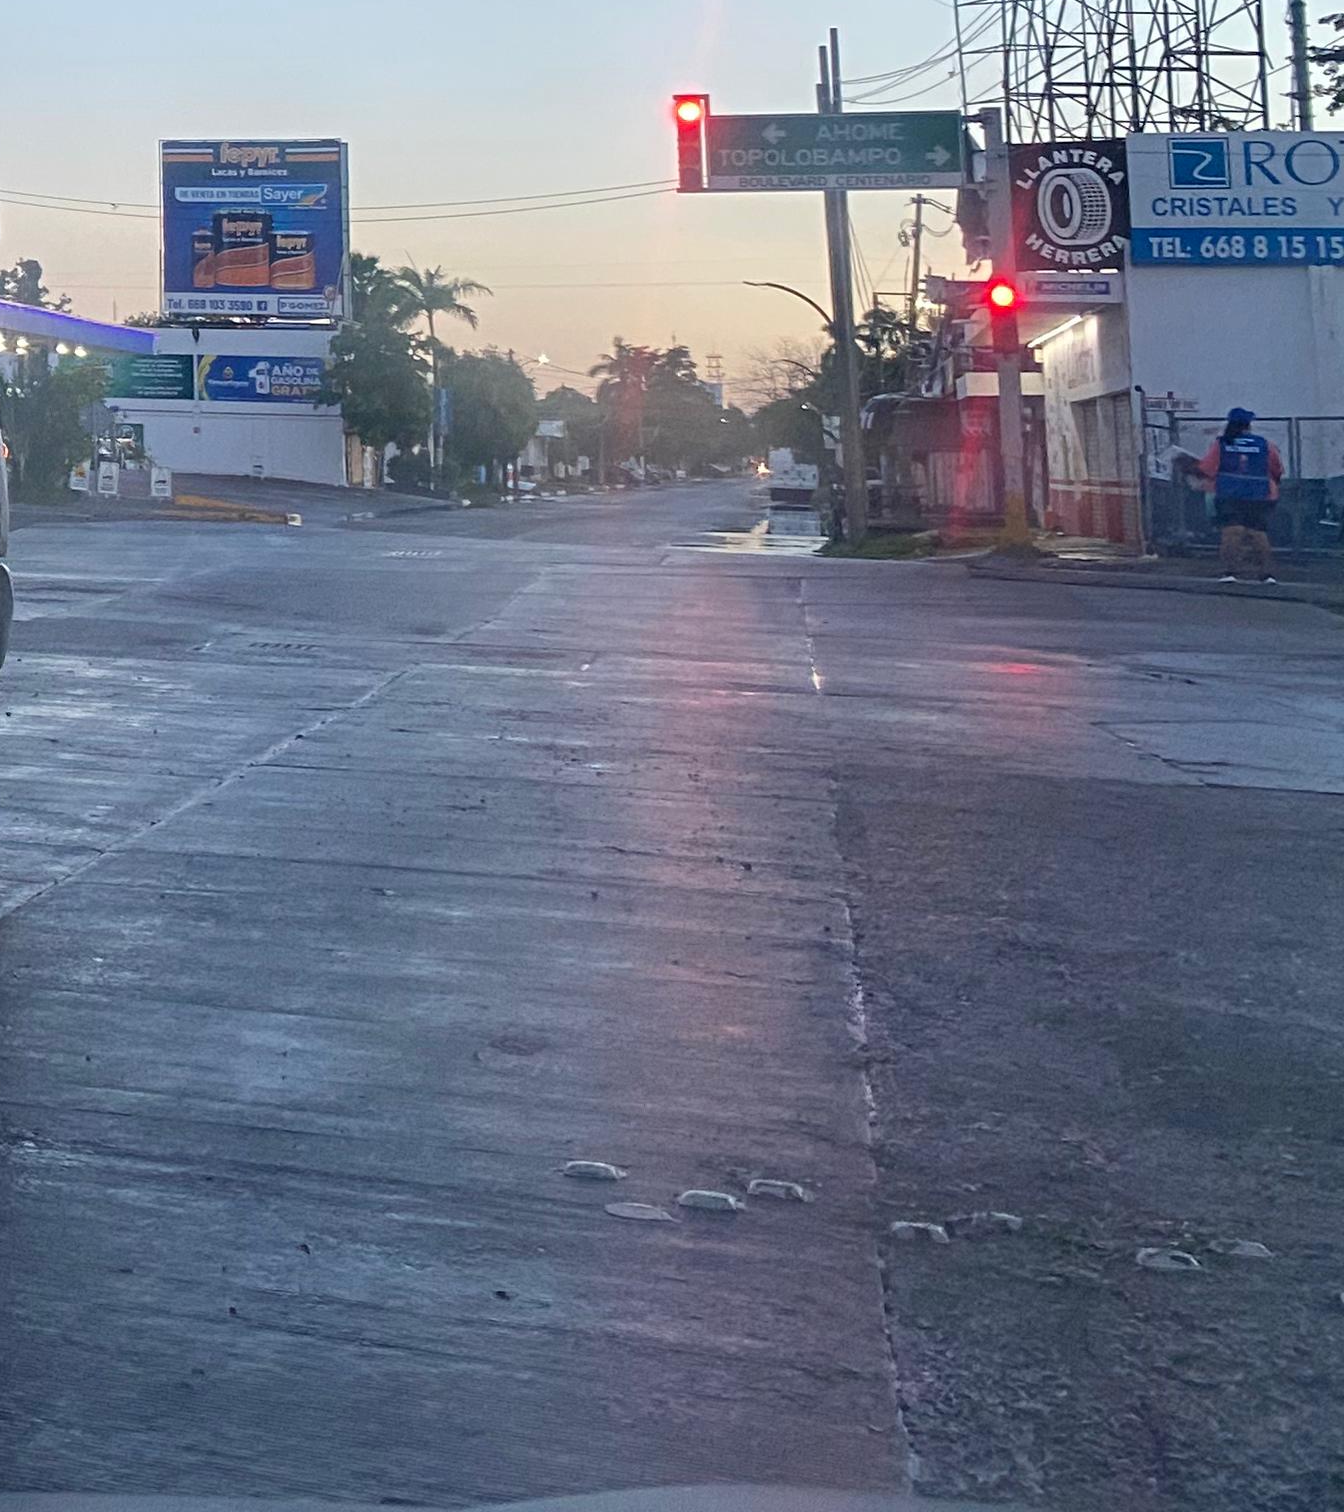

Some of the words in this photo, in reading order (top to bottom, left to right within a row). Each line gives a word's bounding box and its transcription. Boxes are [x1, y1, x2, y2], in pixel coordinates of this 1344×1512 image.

[815, 122, 905, 141] AHOME
[718, 147, 902, 167] TOPOLOBAMPO
[1243, 139, 1344, 186] RO
[1016, 149, 1125, 190] LLANTERA
[738, 175, 827, 188] BOULEVARD
[834, 174, 931, 187] CENTENARIO
[263, 188, 304, 203] Sayer
[1151, 196, 1298, 217] CRISTALES
[1025, 233, 1128, 265] HERRERA
[1200, 236, 1246, 259] 668
[1253, 236, 1268, 258] 8
[1277, 236, 1306, 259] 15
[1316, 236, 1344, 259] 15
[272, 362, 304, 377] AÑO
